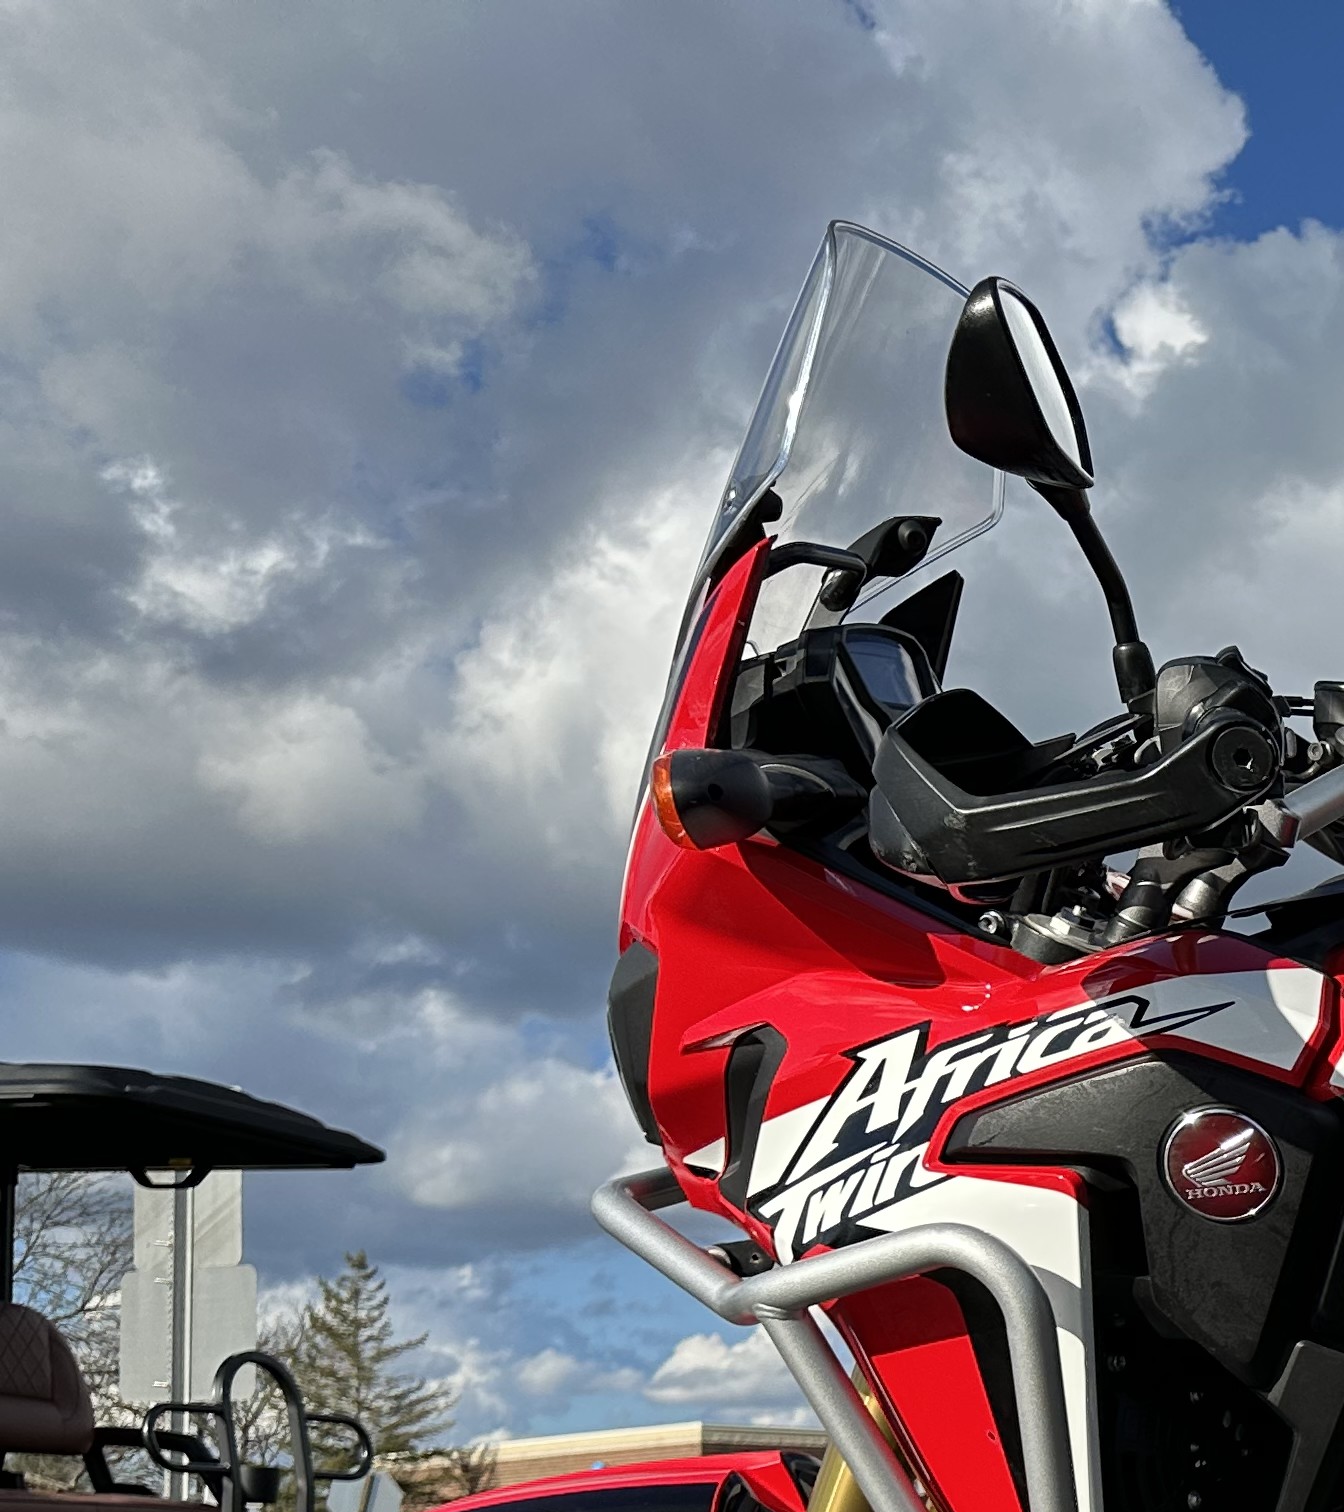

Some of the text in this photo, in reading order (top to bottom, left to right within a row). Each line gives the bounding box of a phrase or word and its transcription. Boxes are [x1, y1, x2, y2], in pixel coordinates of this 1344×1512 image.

[786, 1000, 1137, 1185] Africa
[759, 1142, 950, 1265] Twin
[1186, 1182, 1268, 1200] HONDA
